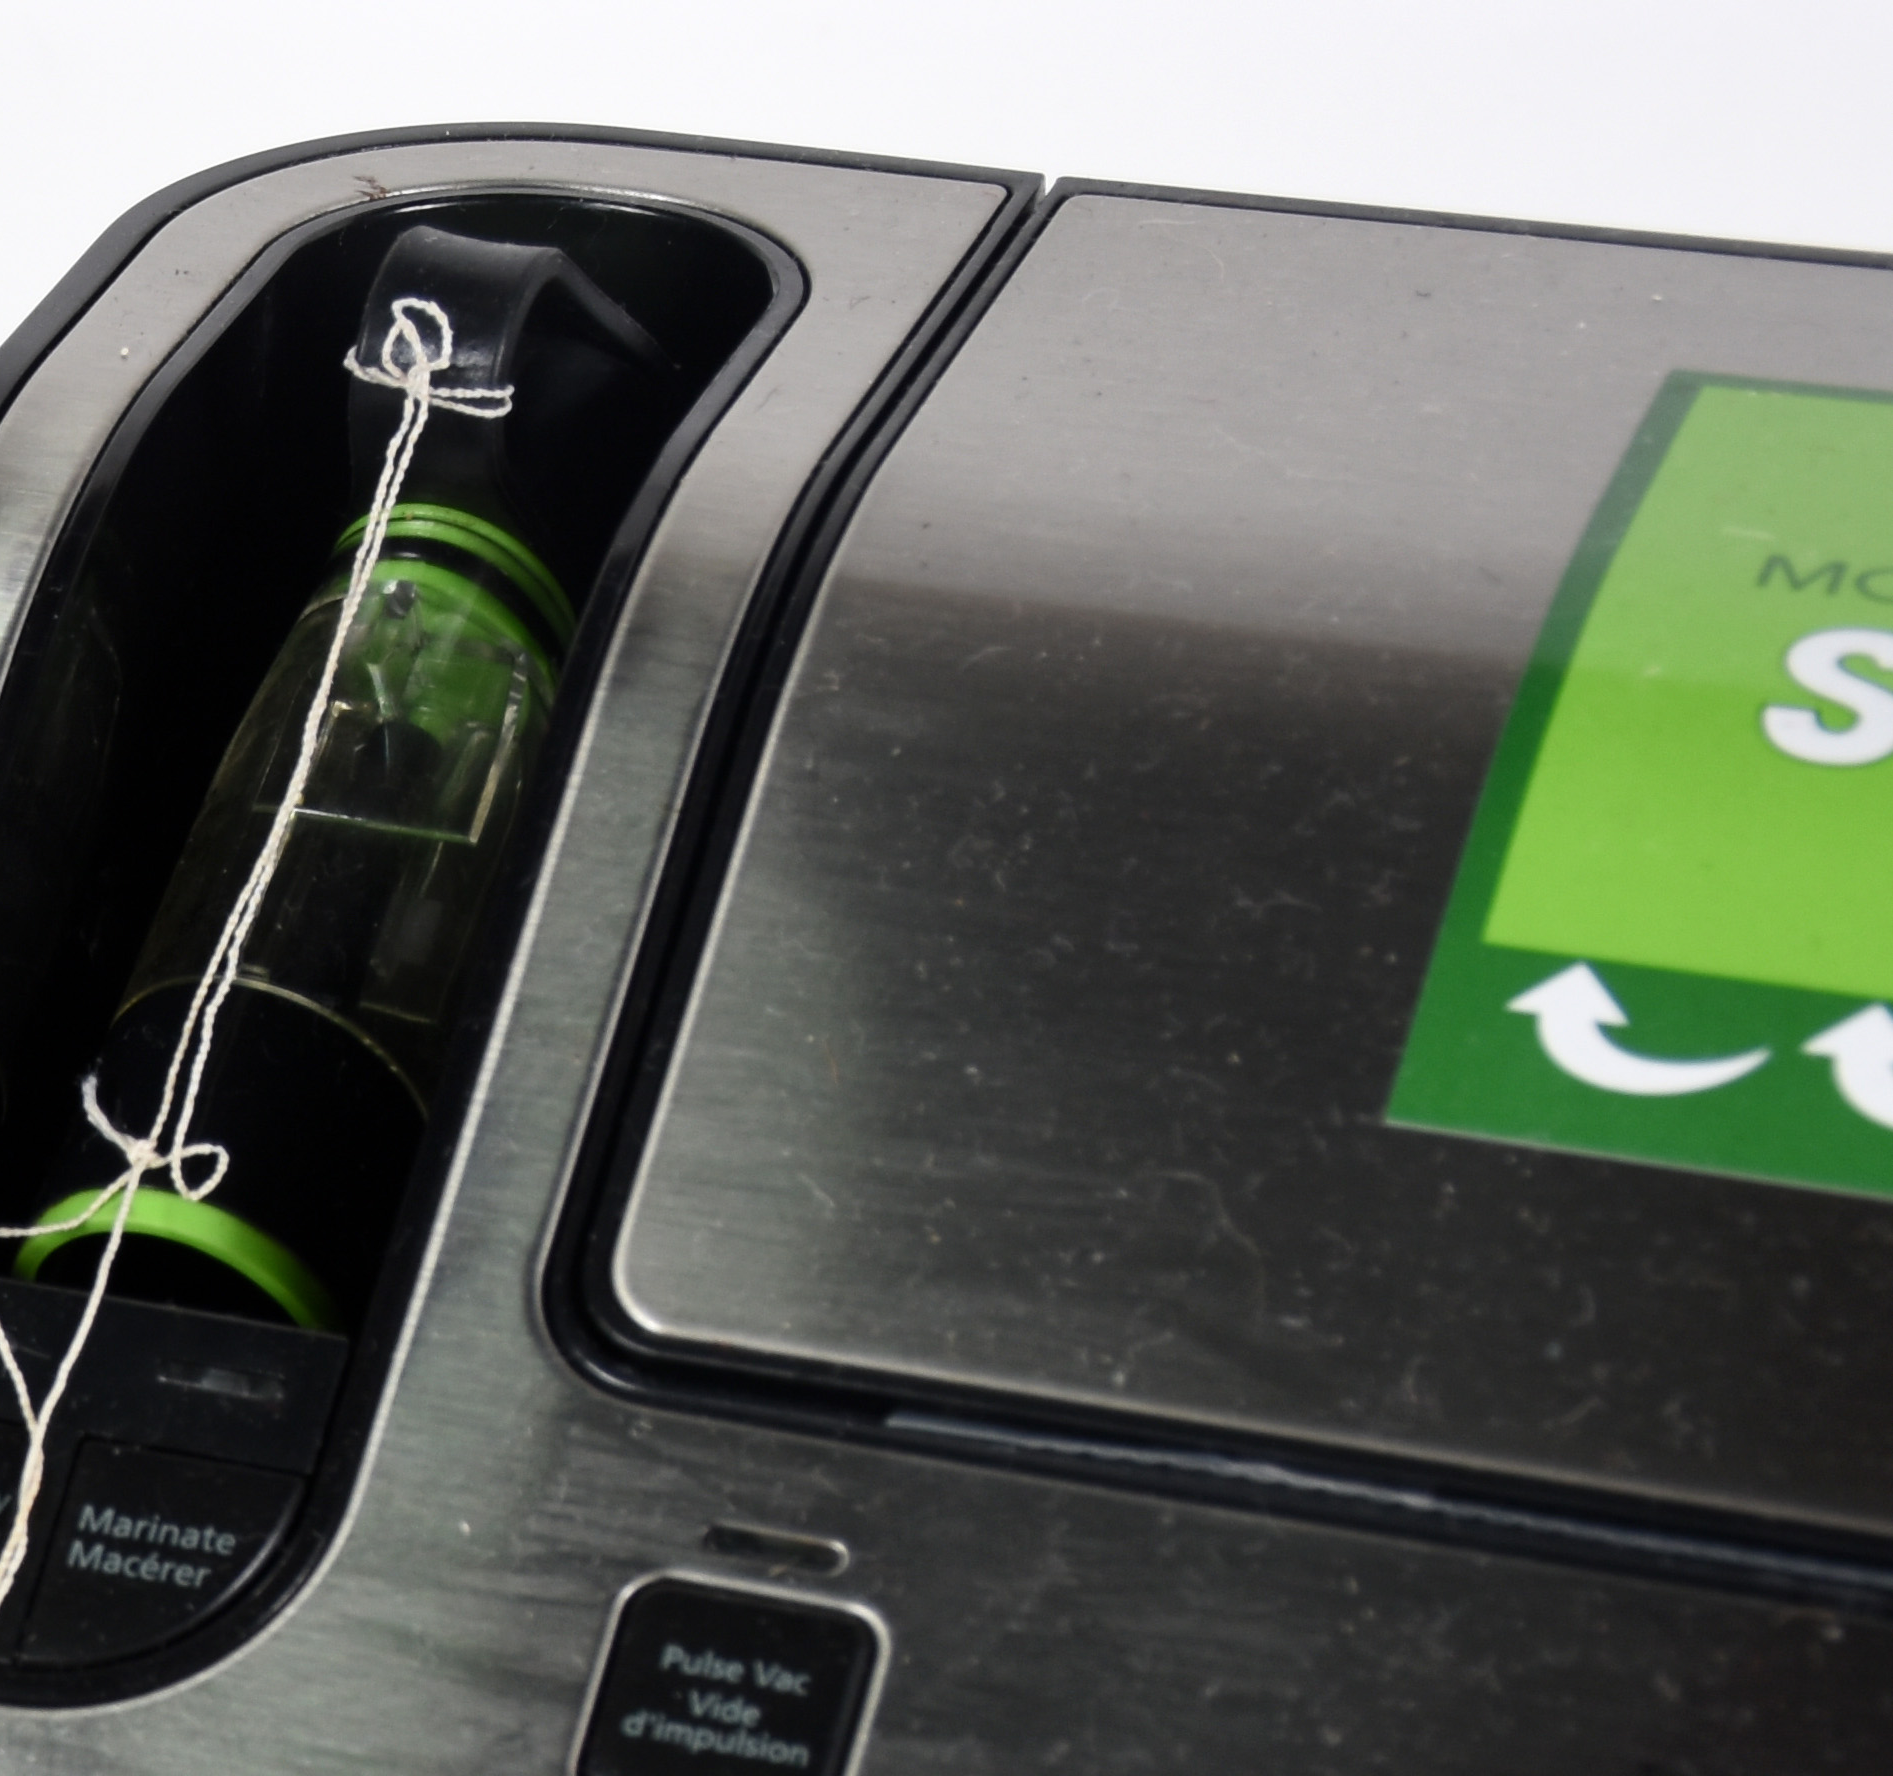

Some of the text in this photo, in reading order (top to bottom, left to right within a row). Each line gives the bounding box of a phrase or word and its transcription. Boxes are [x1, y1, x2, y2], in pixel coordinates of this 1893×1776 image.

[76, 1504, 236, 1556] Marinate
[67, 1539, 213, 1589] Macérer
[660, 1642, 811, 1696] Pulse Vac
[687, 1689, 762, 1728] Vide
[621, 1709, 809, 1768] d'impulsion
